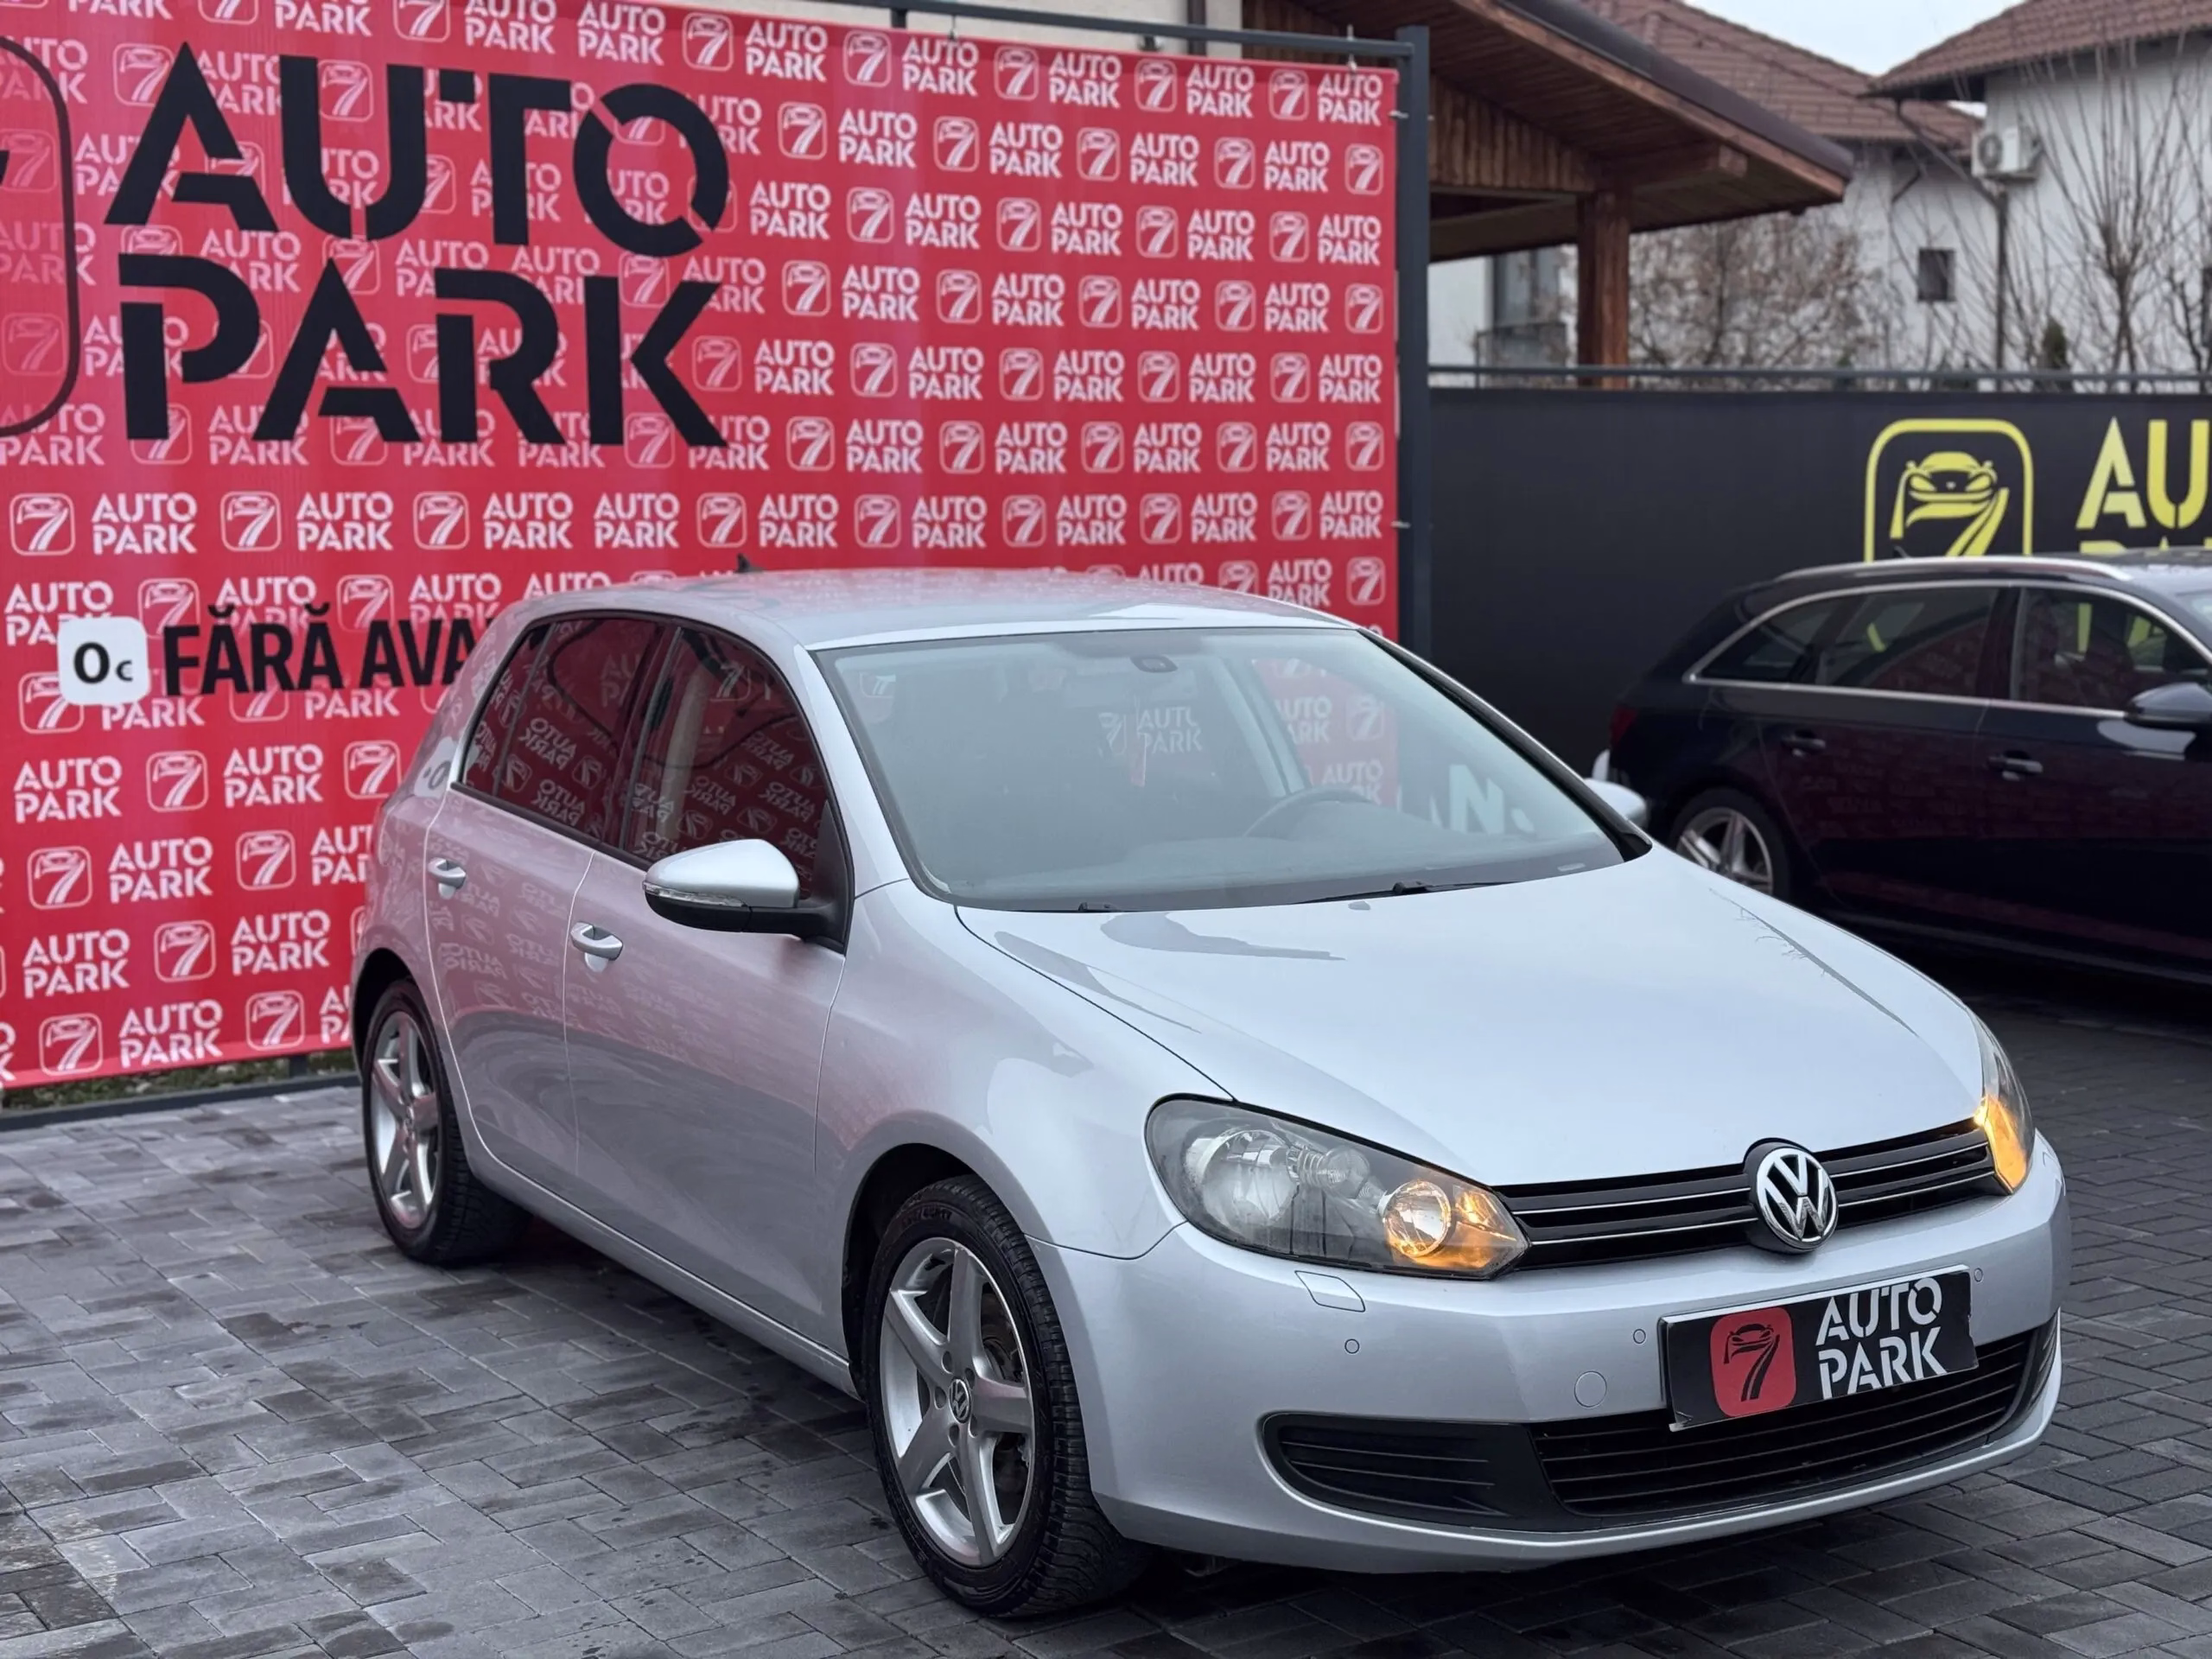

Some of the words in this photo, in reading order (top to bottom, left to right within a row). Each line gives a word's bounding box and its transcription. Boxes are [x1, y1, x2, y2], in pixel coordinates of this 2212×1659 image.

[275, 1, 372, 36] PARK
[577, 2, 664, 35] AUTO
[465, 16, 556, 54] PARK
[579, 29, 663, 65] PARK
[746, 19, 827, 53] AUTO
[747, 47, 826, 81] PARK
[902, 39, 978, 68] AUTO
[1049, 54, 1121, 82] AUTO
[903, 63, 976, 96] PARK
[1049, 76, 1119, 108] PARK
[1186, 66, 1254, 92] AUTO
[1318, 70, 1382, 98] AUTO
[685, 92, 762, 126] UTO
[1187, 88, 1252, 118] PARK
[1318, 96, 1380, 125] PARK
[839, 109, 917, 140] AUTO
[989, 123, 1063, 151] AUTO
[105, 41, 728, 257] AUTO
[840, 135, 915, 168] PARK
[1130, 133, 1199, 160] AUTO
[1264, 142, 1330, 166] AUTO
[990, 147, 1061, 178] PARK
[1130, 156, 1198, 186] PARK
[607, 168, 671, 200] UTO
[1265, 164, 1327, 192] PARK
[751, 181, 830, 212] AUTO
[905, 194, 981, 222] AUTO
[751, 208, 829, 239] PARK
[1051, 202, 1122, 231] AUTO
[1188, 210, 1255, 235] AUTO
[1318, 214, 1381, 242] AUTO
[200, 229, 302, 262] AUTO
[906, 219, 979, 248] PARK
[1052, 226, 1121, 255] PARK
[1188, 234, 1253, 261] PARK
[396, 239, 489, 271] AUTO
[512, 245, 601, 276] AUTO
[1319, 238, 1379, 265] PARK
[682, 256, 766, 286] AUTO
[842, 265, 919, 294] AUTO
[992, 273, 1065, 300] AUTO
[1131, 279, 1200, 304] AUTO
[1265, 283, 1330, 308] AUTO
[843, 290, 918, 321] PARK
[993, 299, 1063, 326] PARK
[1132, 303, 1198, 330] PARK
[1265, 307, 1327, 332] PARK
[118, 253, 728, 447] PARK
[755, 340, 835, 369] AUTO
[908, 346, 983, 373] AUTO
[1053, 350, 1124, 376] AUTO
[1189, 353, 1255, 378] AUTO
[1319, 354, 1382, 378] AUTO
[756, 366, 833, 395] PARK
[909, 372, 982, 399] PARK
[1054, 375, 1122, 401] PARK
[1190, 377, 1254, 402] PARK
[1319, 378, 1380, 403] PARK
[709, 415, 771, 443] UTO
[846, 420, 923, 446] AUTO
[995, 422, 1067, 448] AUTO
[1134, 423, 1202, 448] AUTO
[1266, 422, 1331, 447] AUTO
[0, 435, 105, 467] PARK
[208, 435, 310, 467] PARK
[403, 440, 495, 468] PARK
[518, 442, 606, 469] PARK
[689, 444, 770, 471] PARK
[847, 445, 922, 473] PARK
[996, 448, 1065, 473] PARK
[1135, 448, 1200, 472] PARK
[1267, 446, 1329, 471] PARK
[92, 493, 196, 523] AUTO
[296, 492, 393, 521] AUTO
[483, 493, 573, 520] AUTO
[594, 493, 679, 520] AUTO
[759, 494, 838, 521] AUTO
[912, 496, 987, 523] AUTO
[1057, 494, 1127, 520] AUTO
[1191, 493, 1257, 518] AUTO
[1320, 491, 1383, 515] AUTO
[93, 524, 195, 554] PARK
[298, 521, 392, 550] PARK
[485, 519, 572, 549] PARK
[595, 519, 678, 548] PARK
[760, 520, 836, 547] PARK
[912, 522, 985, 548] PARK
[1057, 519, 1125, 545] PARK
[1192, 516, 1255, 542] PARK
[1320, 514, 1381, 538] PARK
[1267, 558, 1332, 583] AUTO
[4, 581, 113, 613] AUTO
[216, 575, 316, 607] AUTO
[409, 573, 501, 603] AUTO
[162, 602, 345, 697] FĂRĂ
[359, 617, 494, 688] AVA
[101, 696, 205, 731] PARK
[304, 690, 400, 720] PARK
[14, 756, 122, 791] AUTO
[224, 744, 323, 778] AUTO
[16, 786, 121, 823] PARK
[225, 773, 322, 807] PARK
[109, 837, 213, 873] AUTO
[110, 867, 212, 903] PARK
[232, 910, 330, 945] AUTO
[23, 929, 130, 967] AUTO
[232, 938, 329, 975] PARK
[24, 959, 129, 998] PARK
[119, 1000, 222, 1038] AUTO
[121, 1029, 223, 1069] PARK
[1816, 1277, 1942, 1346] AUTO
[1818, 1326, 1948, 1400] PARK
